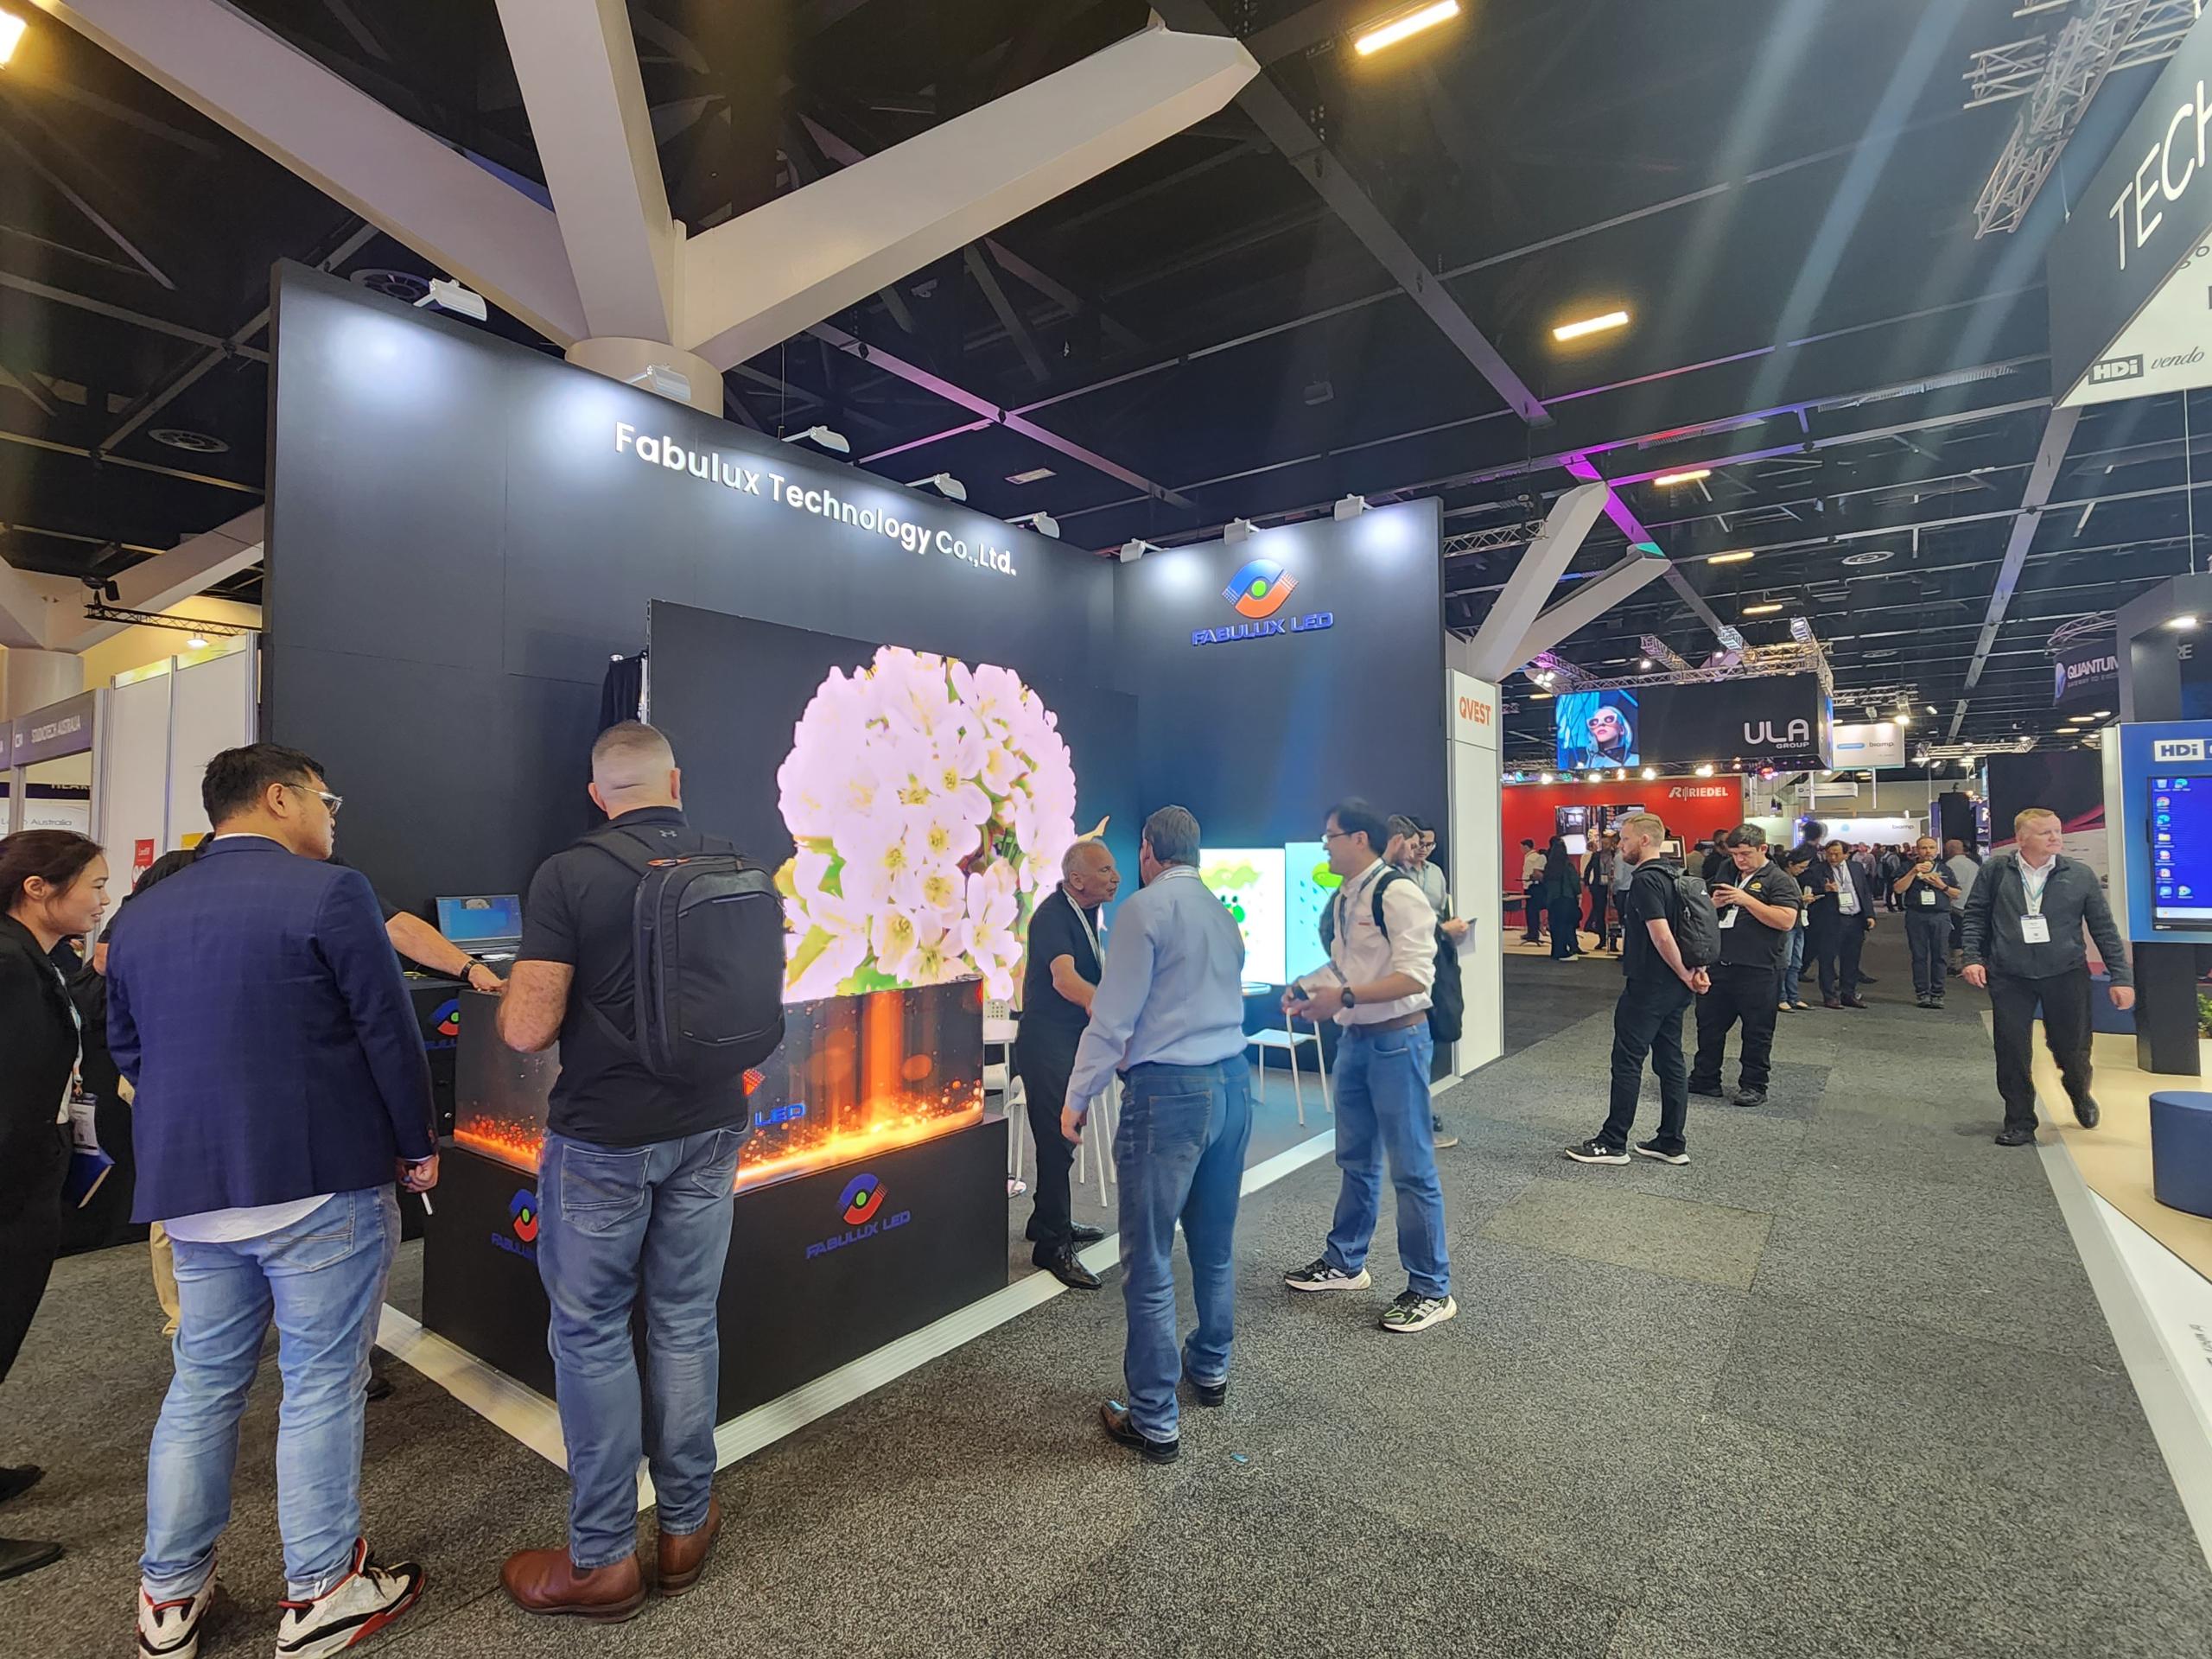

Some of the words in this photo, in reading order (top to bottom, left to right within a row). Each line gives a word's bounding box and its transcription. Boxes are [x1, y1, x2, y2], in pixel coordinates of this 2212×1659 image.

[2093, 359, 2139, 381] HDi
[2151, 346, 2205, 370] vendo
[615, 421, 760, 495] Fabulux
[768, 473, 931, 555] Technology
[1192, 618, 1286, 646] FABULUX
[1291, 612, 1334, 632] LED
[1459, 696, 1491, 726] QVEST
[1744, 718, 1809, 745] ULA
[2160, 744, 2198, 757] HDi
[1688, 787, 1729, 798] RIEDEL
[754, 1102, 806, 1127] LED
[804, 1222, 879, 1259] FABULUX
[882, 1210, 911, 1230] LED
